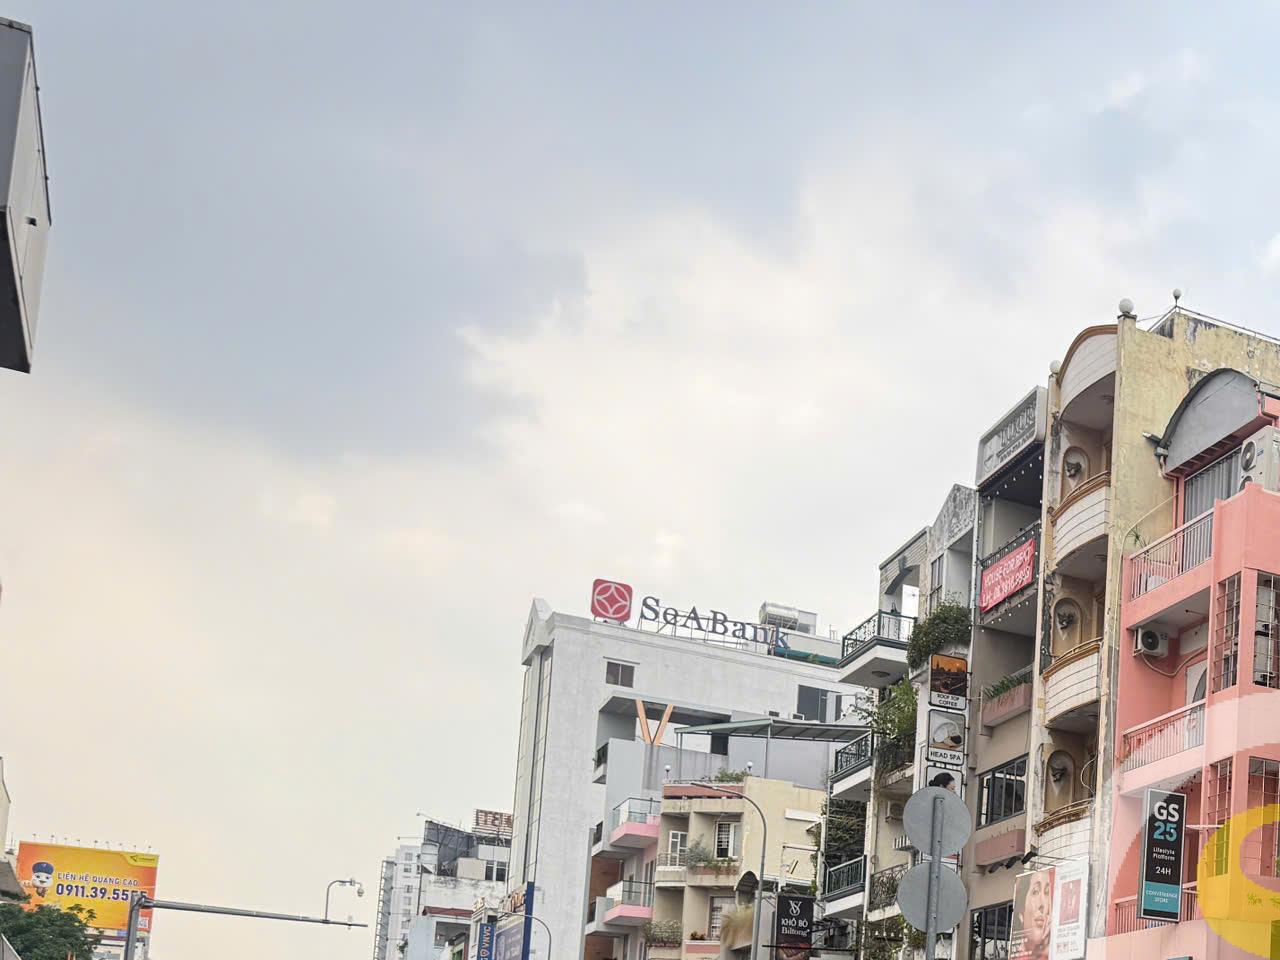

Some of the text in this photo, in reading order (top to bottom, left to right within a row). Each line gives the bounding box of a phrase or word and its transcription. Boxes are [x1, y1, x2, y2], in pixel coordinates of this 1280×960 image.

[641, 595, 791, 651] SeABank
[930, 751, 961, 761] HEAD SPA
[1154, 801, 1180, 822] GS
[1153, 821, 1178, 842] 25
[1155, 866, 1172, 876] 24H
[782, 918, 796, 926] KHÔ
